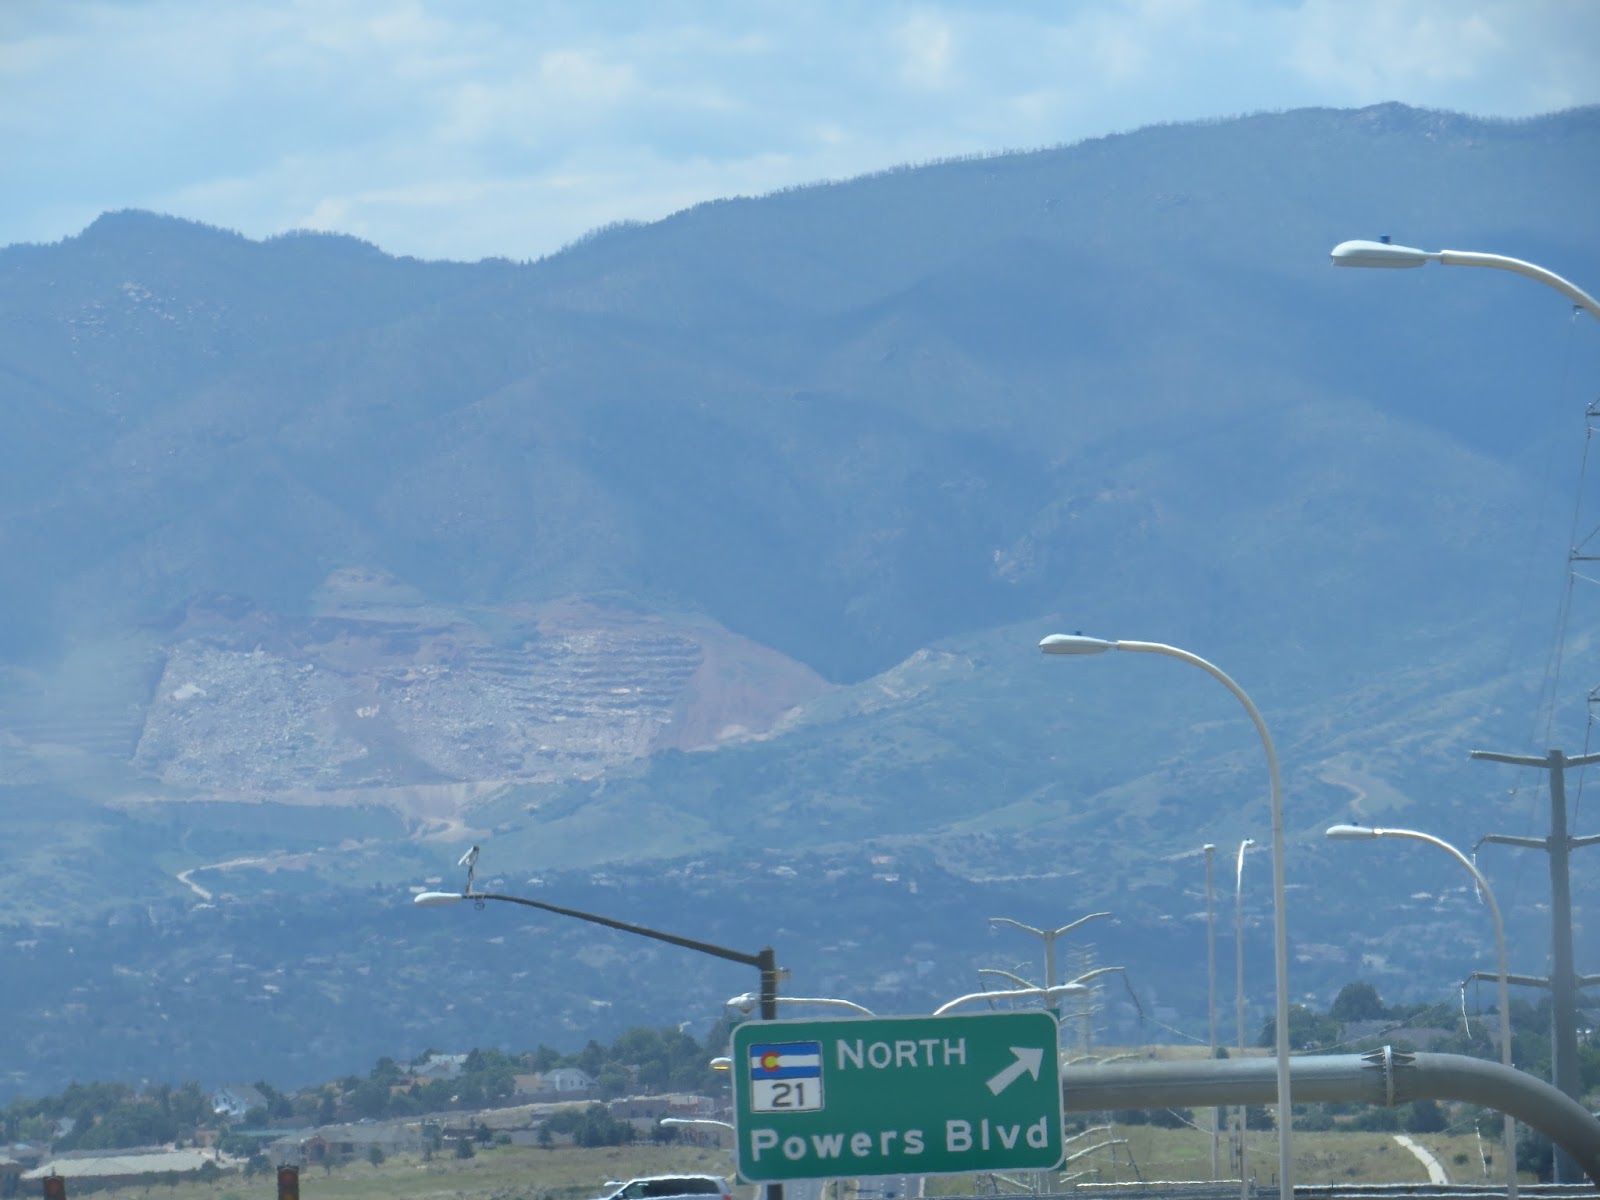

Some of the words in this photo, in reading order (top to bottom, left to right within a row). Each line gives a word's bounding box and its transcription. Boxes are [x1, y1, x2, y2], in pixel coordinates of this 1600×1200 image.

[836, 1038, 967, 1071] NORTH
[771, 1082, 805, 1108] 21
[751, 1128, 925, 1162] Powers
[946, 1115, 1049, 1153] Blvd
